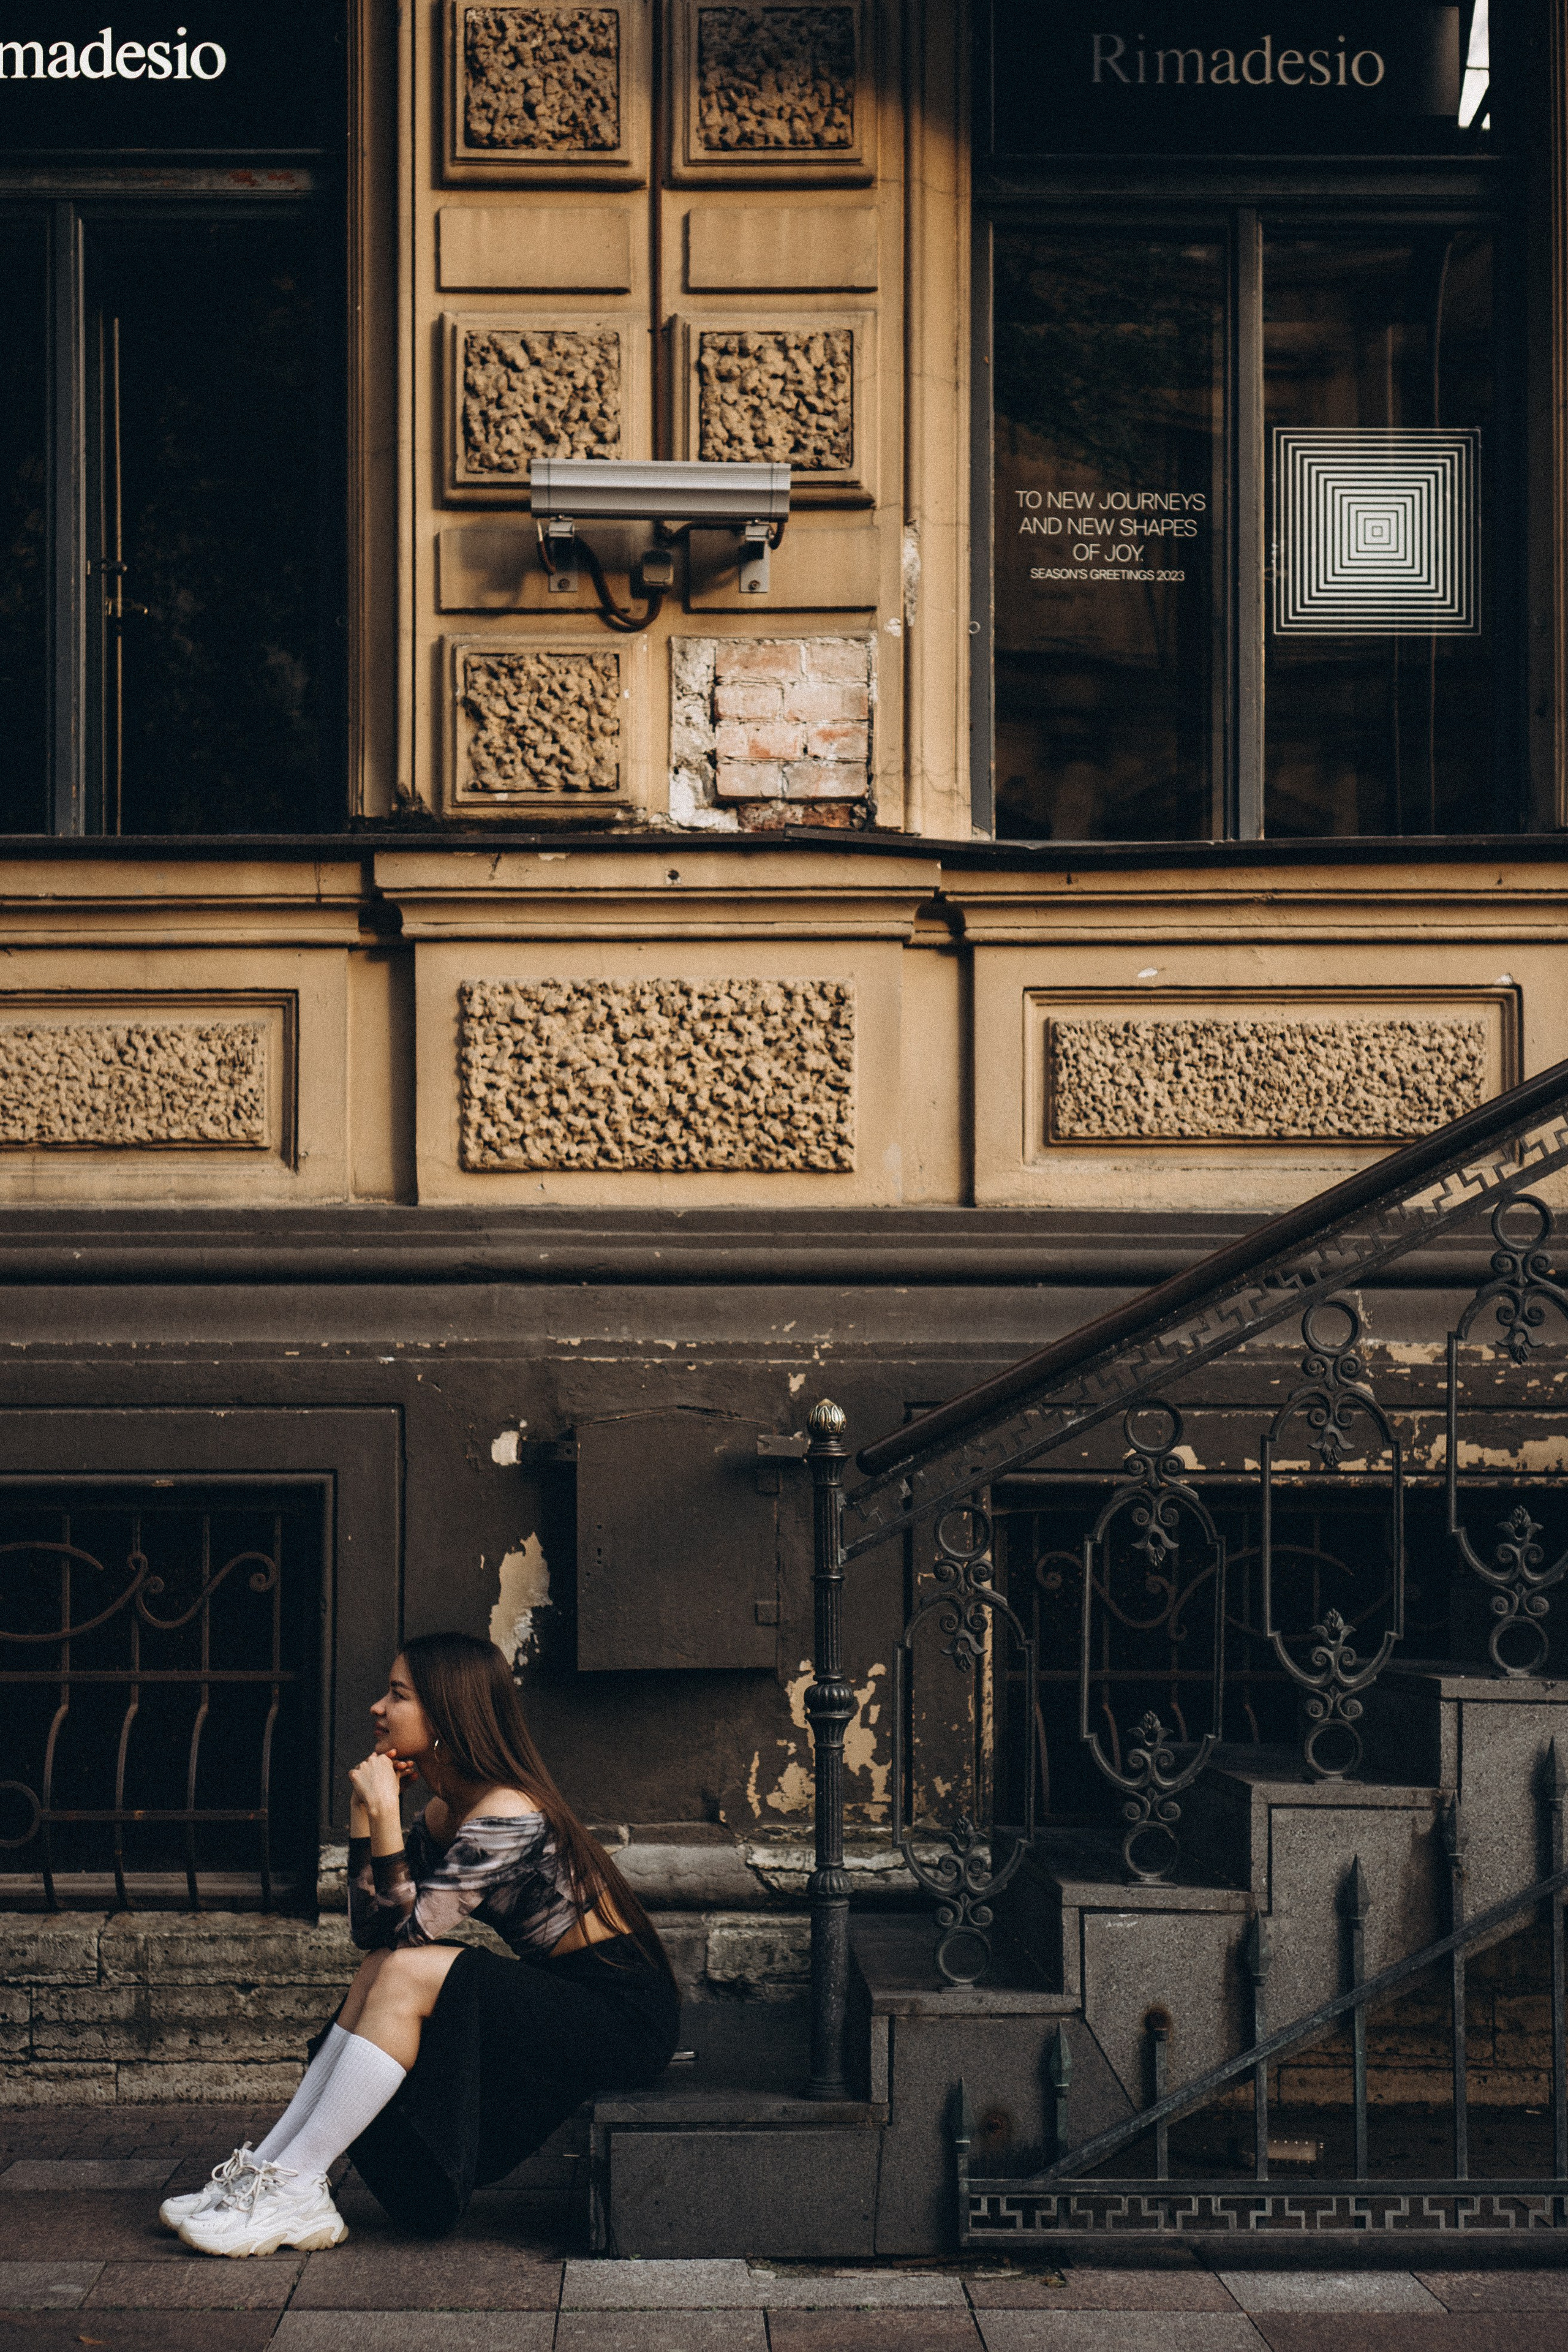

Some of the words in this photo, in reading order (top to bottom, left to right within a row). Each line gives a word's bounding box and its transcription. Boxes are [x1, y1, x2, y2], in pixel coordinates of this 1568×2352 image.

[1091, 32, 1385, 87] Rimadesio
[1014, 490, 1042, 509] TO
[1047, 491, 1095, 510] NEW
[1098, 492, 1207, 512] JOURNEYS
[1018, 516, 1063, 535] AND
[1067, 518, 1115, 536] NEW
[1119, 518, 1198, 537] SHAPES
[1072, 543, 1101, 562] OF
[1104, 544, 1145, 562] JOY.
[1030, 568, 1088, 581] SEASON'S
[1090, 569, 1155, 581] GREETINGS
[1156, 570, 1185, 582] 2023
